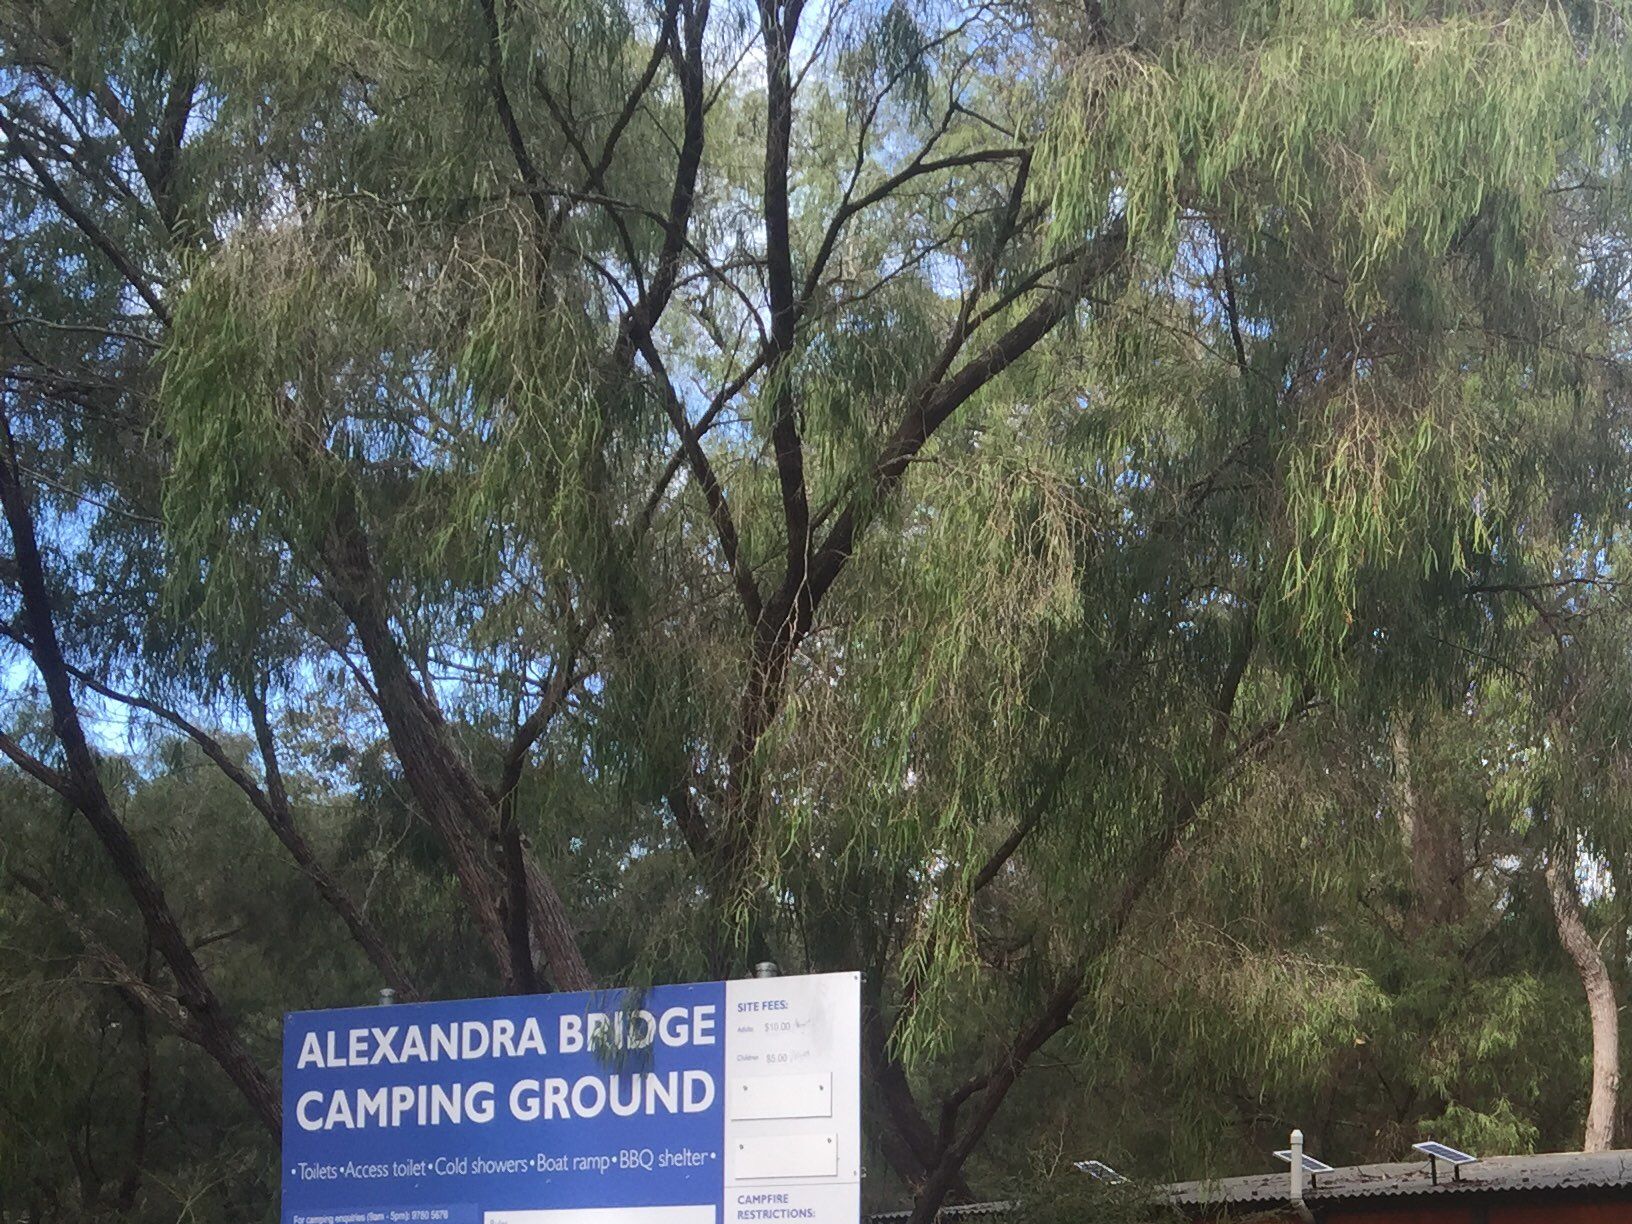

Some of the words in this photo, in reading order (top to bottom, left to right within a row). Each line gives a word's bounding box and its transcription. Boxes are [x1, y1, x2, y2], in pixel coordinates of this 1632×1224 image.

[737, 1001, 760, 1013] SITE
[762, 1000, 789, 1011] FEES:
[297, 1017, 546, 1069] ALEXANDRA
[559, 1005, 716, 1054] BRIDGE
[296, 1081, 495, 1131] CAMPING
[509, 1070, 715, 1122] GROUND
[298, 1162, 338, 1181] Toilets
[344, 1161, 389, 1179] Access
[393, 1159, 426, 1177] toilet
[435, 1157, 467, 1175] Cold
[472, 1156, 528, 1175] showers
[537, 1153, 568, 1172] Boat
[573, 1156, 610, 1174] ramp
[620, 1149, 654, 1171] BBQ
[659, 1148, 708, 1168] shelter
[737, 1194, 789, 1205] CAMPFIRE
[293, 1215, 305, 1224] For
[737, 1208, 816, 1220] RESTRICTIONS:
